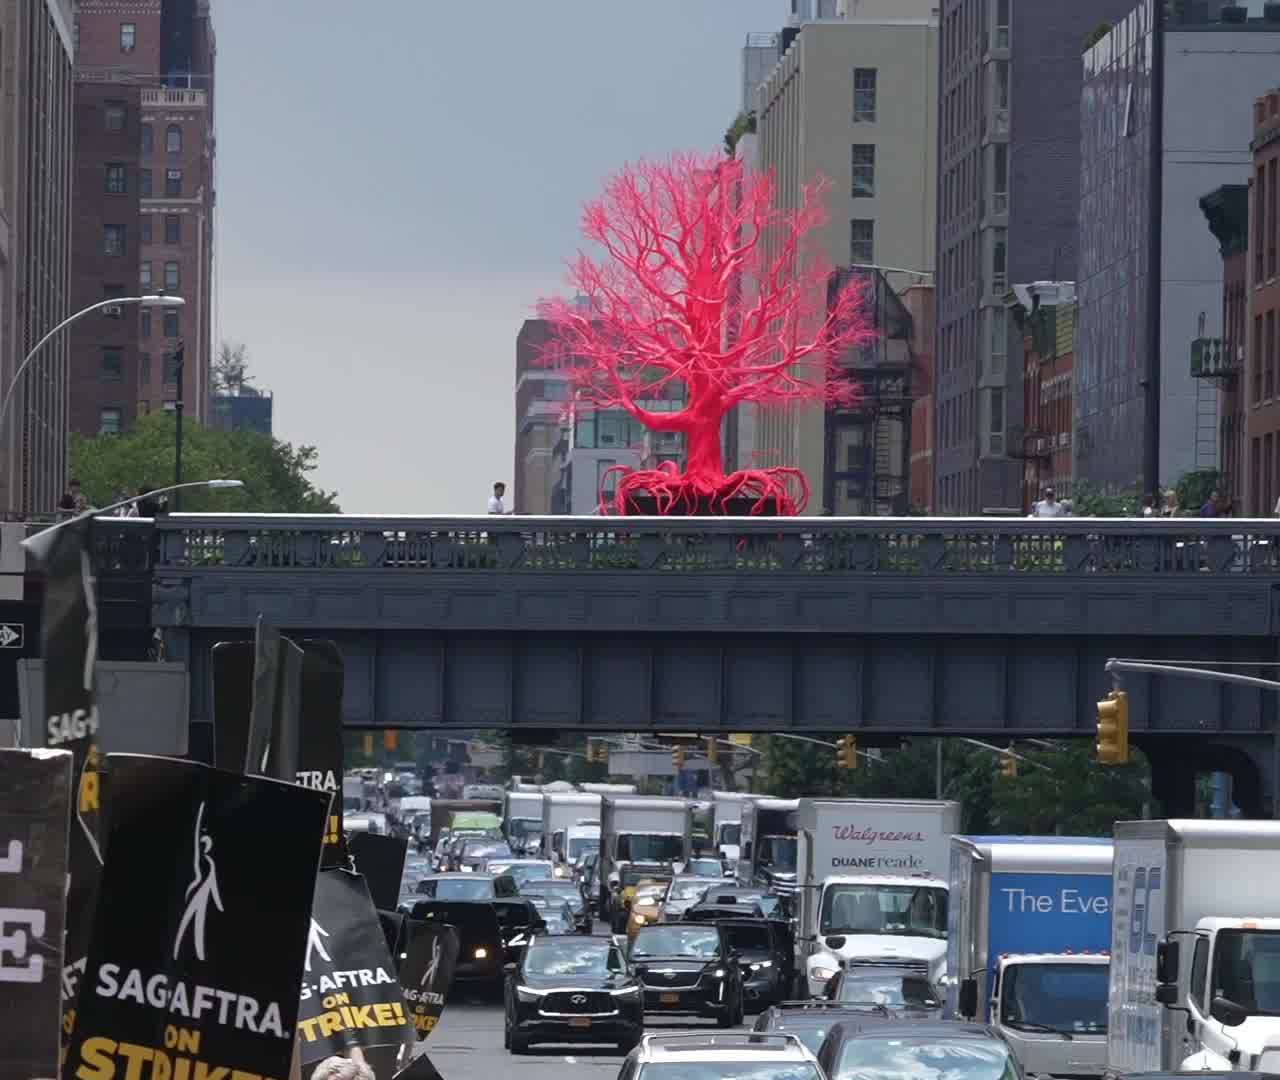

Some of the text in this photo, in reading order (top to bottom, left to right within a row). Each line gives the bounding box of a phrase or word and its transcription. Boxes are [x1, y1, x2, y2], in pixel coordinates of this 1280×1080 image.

[832, 824, 925, 846] Walgreens
[832, 855, 923, 868] DUANE reade
[1000, 888, 1109, 914] The Eve
[300, 966, 397, 1000] G·AFTRA.
[322, 992, 349, 1008] ON
[297, 1002, 408, 1042] TRIKE!
[164, 1024, 200, 1053] ON
